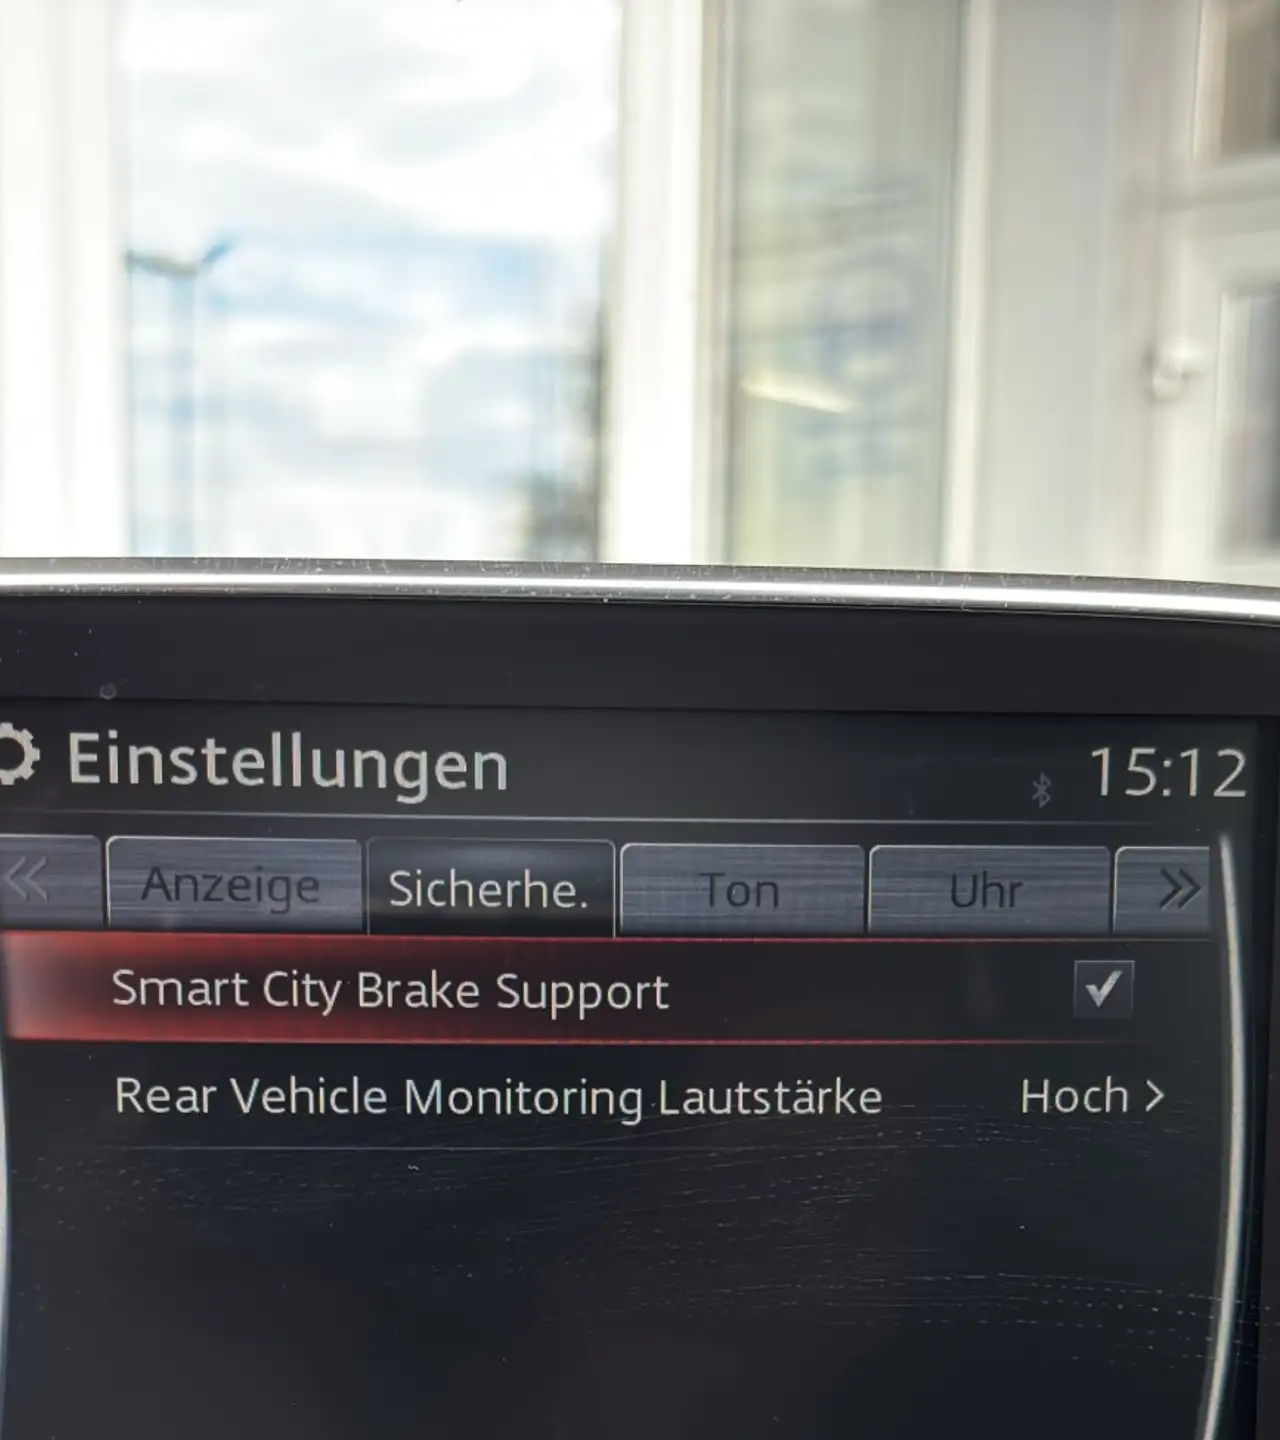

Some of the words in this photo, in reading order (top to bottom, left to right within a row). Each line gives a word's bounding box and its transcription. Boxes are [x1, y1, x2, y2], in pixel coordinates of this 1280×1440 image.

[68, 731, 510, 803] Einstellungen
[1089, 746, 1248, 799] 15:12
[141, 865, 321, 915] Anzeige
[388, 869, 589, 909] Sicherhe.
[698, 871, 780, 909] Ton
[949, 871, 1024, 909] Uhr
[112, 969, 249, 1008] Smart
[262, 969, 343, 1017] City
[357, 970, 480, 1009] Brake
[496, 971, 670, 1021] Support
[115, 1076, 218, 1115] Rear
[228, 1076, 388, 1116] Vehicle
[404, 1076, 643, 1126] Monitoring
[658, 1076, 883, 1117] Lautstärke
[1021, 1077, 1129, 1114] Hoch
